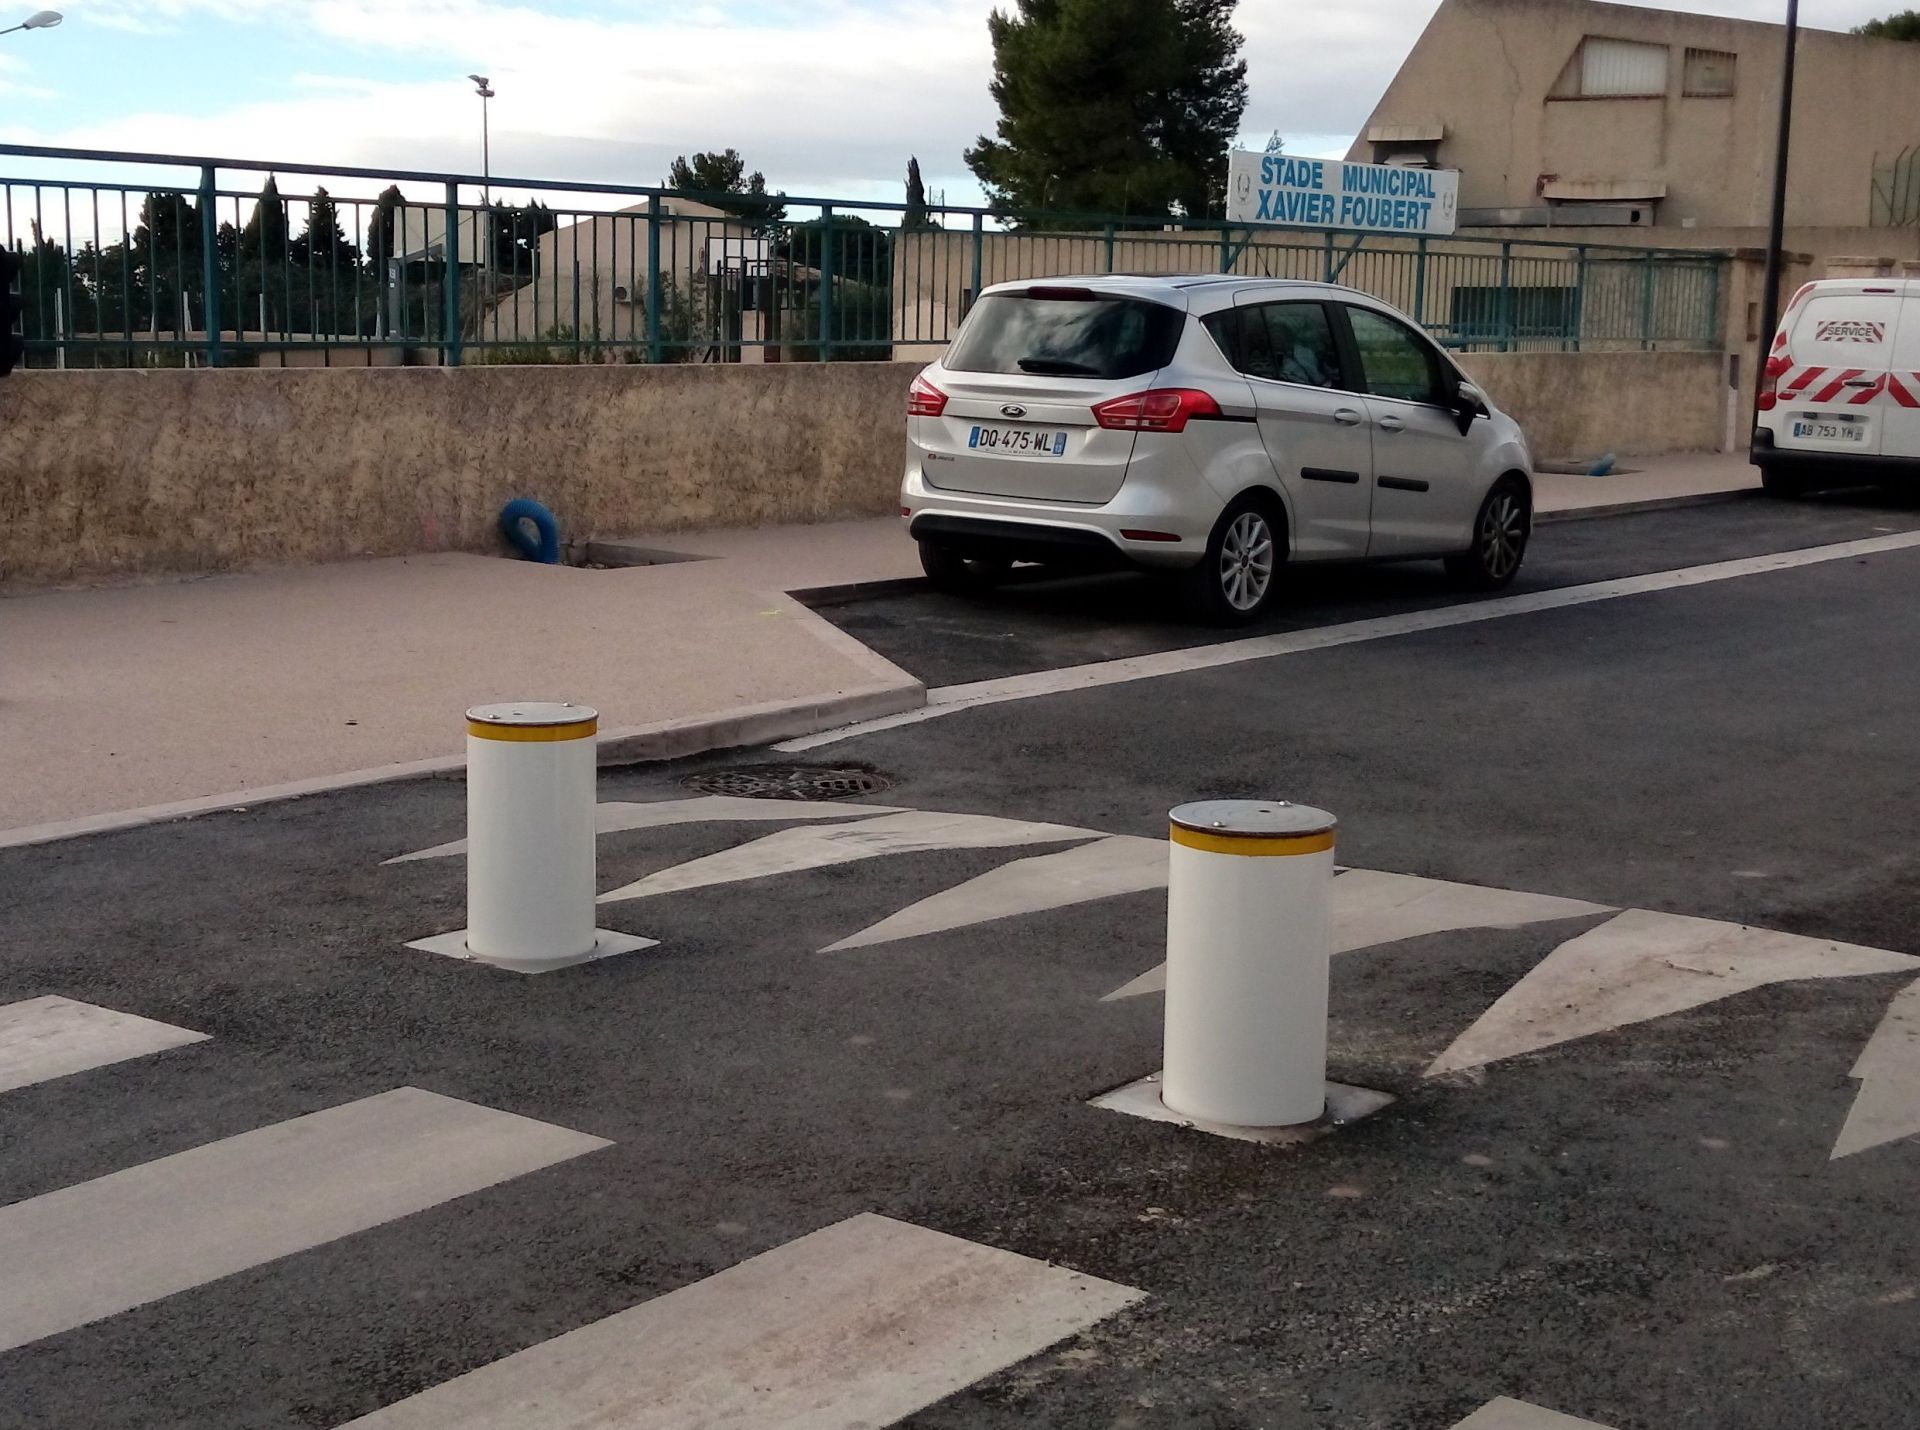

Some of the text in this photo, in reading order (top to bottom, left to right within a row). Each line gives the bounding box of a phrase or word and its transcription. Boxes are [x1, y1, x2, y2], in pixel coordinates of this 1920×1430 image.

[1261, 156, 1436, 198] STADE MUNICIPAL
[1256, 189, 1431, 229] XAVIER FOUBERT
[1827, 326, 1873, 337] SERVICE
[979, 429, 1051, 452] DQ-475-WL
[1818, 425, 1836, 437] 753
